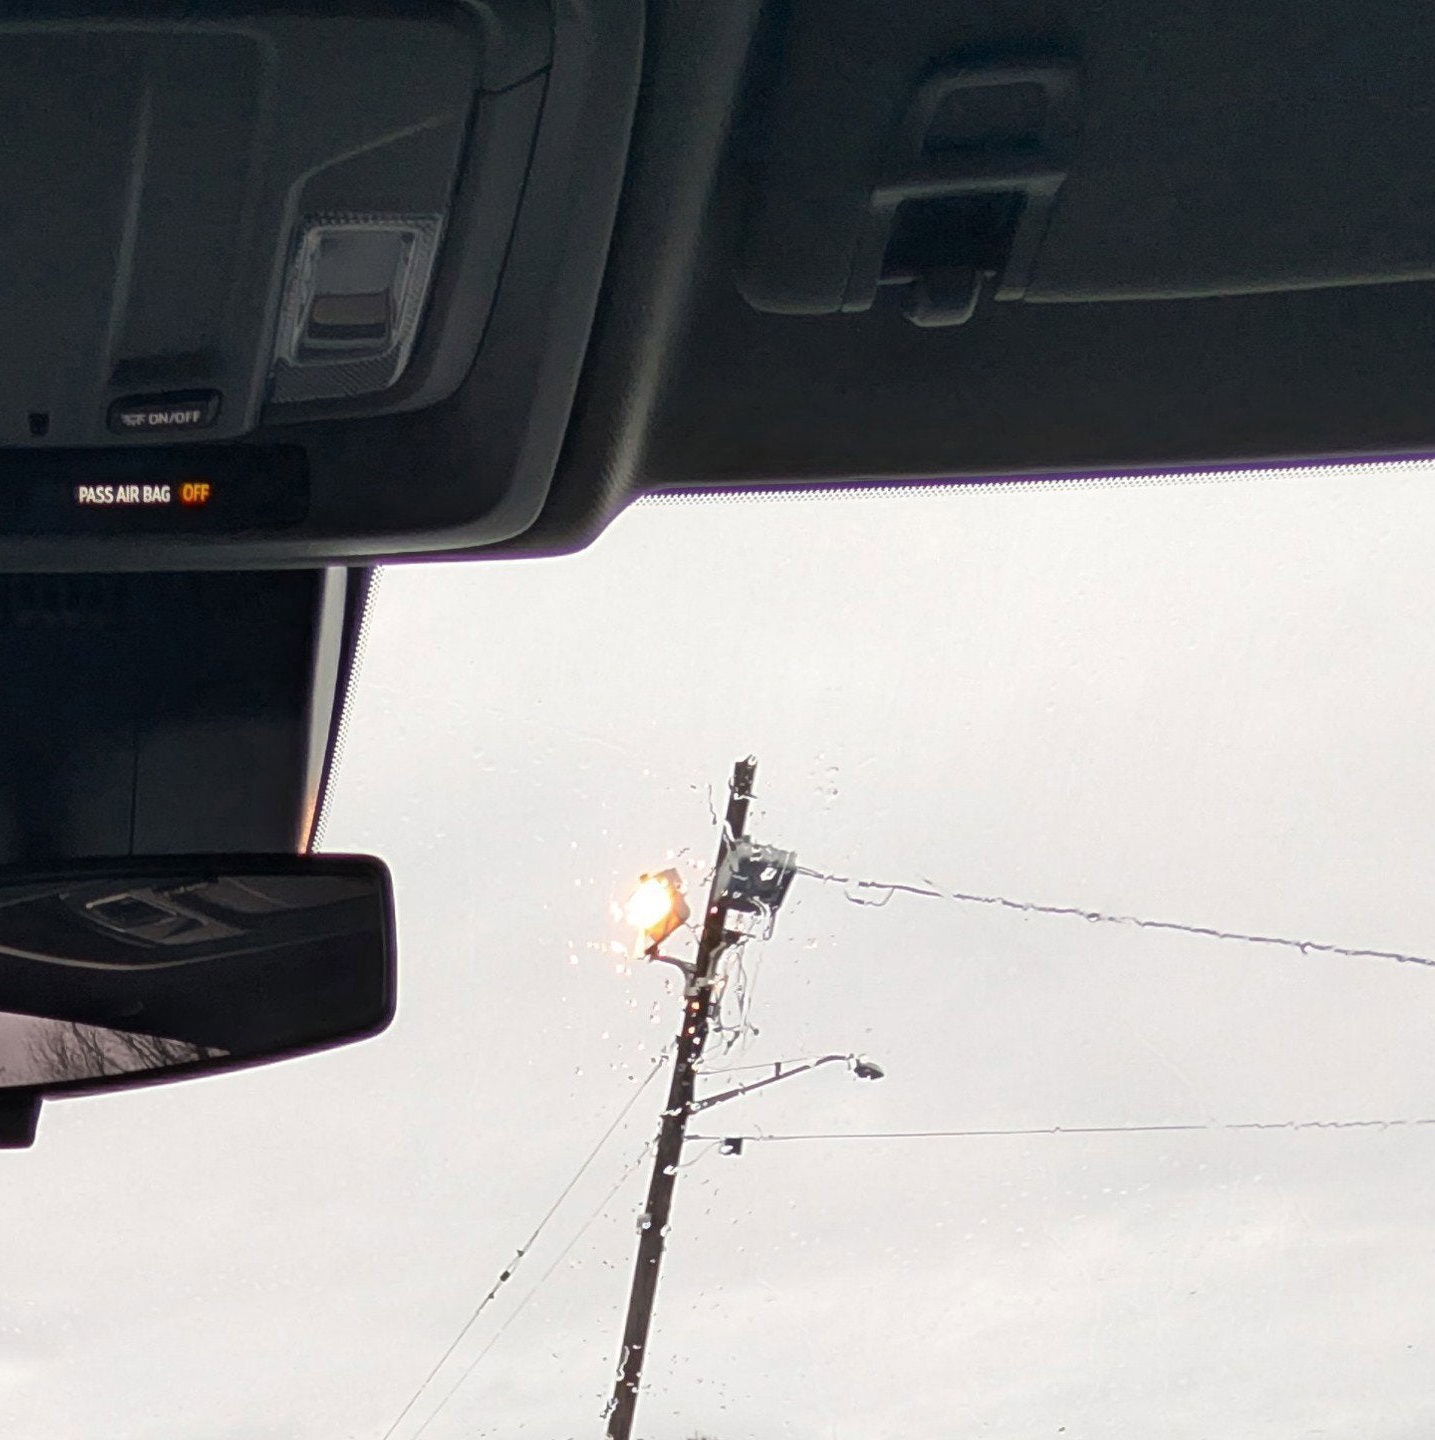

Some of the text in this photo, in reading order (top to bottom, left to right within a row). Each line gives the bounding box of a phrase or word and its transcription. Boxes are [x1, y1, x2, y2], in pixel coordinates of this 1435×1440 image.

[149, 410, 201, 425] ON/OFF
[79, 484, 209, 504] PASS AIR BAG OFF
